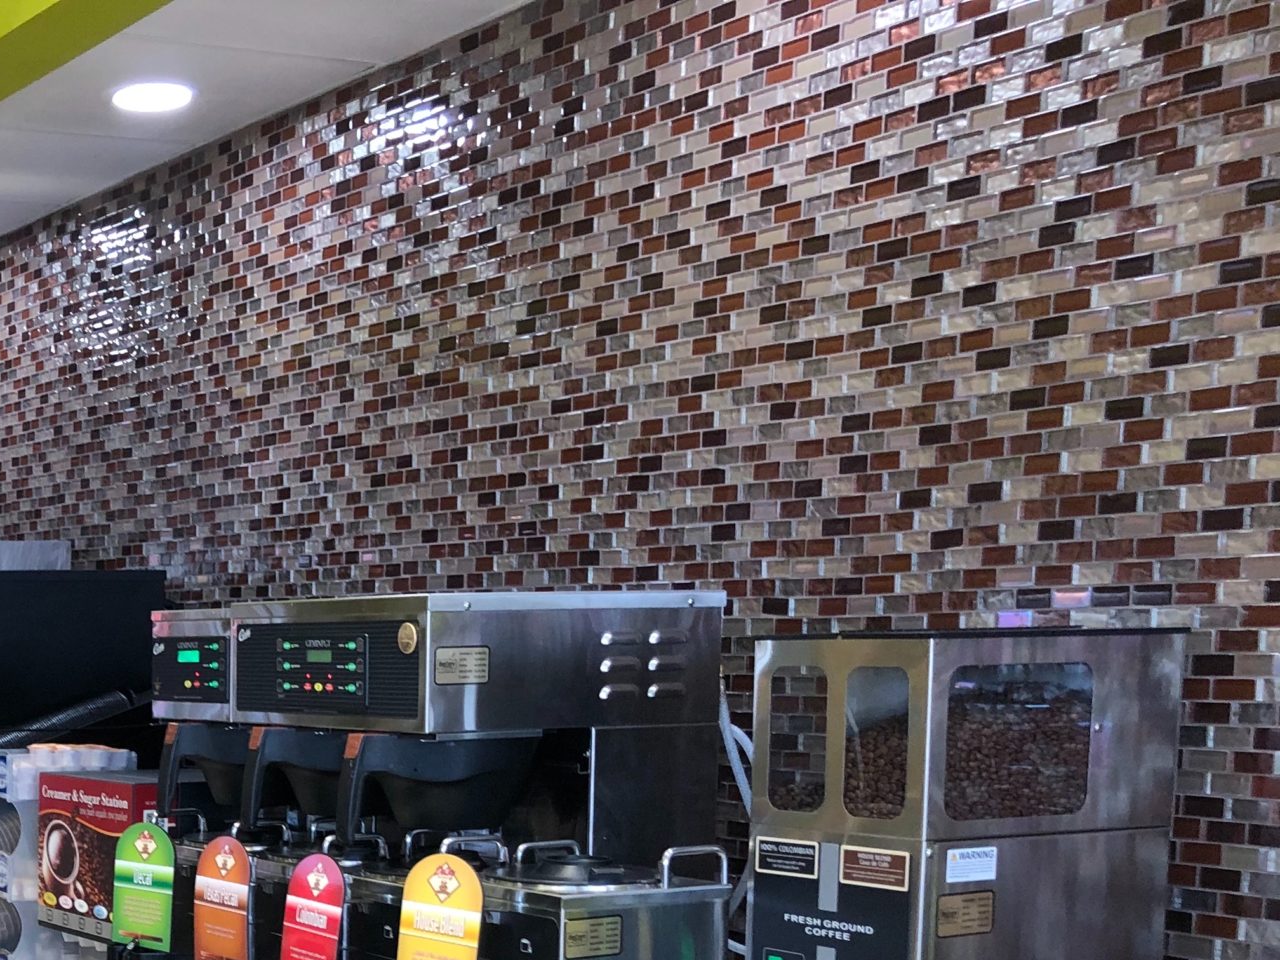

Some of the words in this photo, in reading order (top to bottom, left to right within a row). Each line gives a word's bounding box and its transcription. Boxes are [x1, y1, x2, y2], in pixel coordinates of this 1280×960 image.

[41, 784, 71, 801] Creamer
[71, 789, 78, 802] &
[79, 789, 100, 808] Sugar
[101, 792, 128, 809] Station
[959, 849, 994, 861] WARNING
[413, 911, 439, 933] House
[783, 913, 821, 926] FRESH
[822, 919, 874, 935] GROUND
[804, 926, 851, 941] COFFEE
